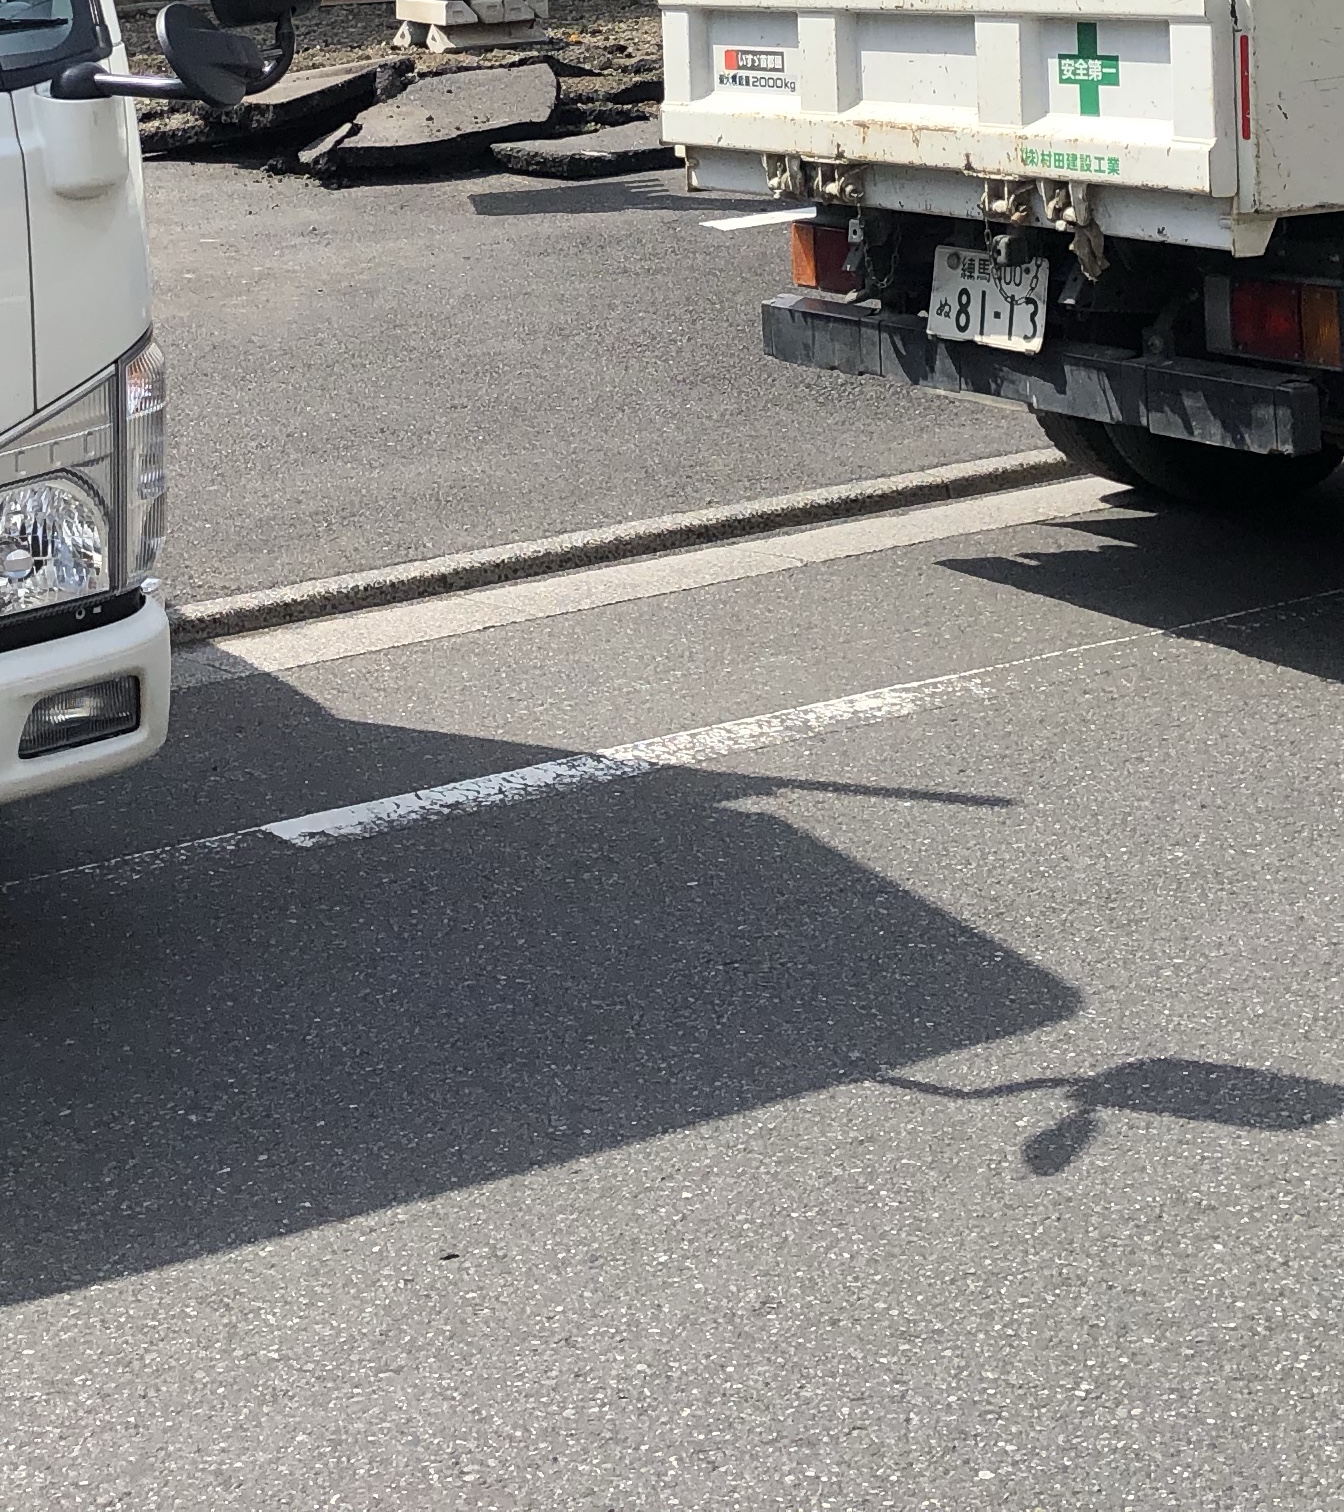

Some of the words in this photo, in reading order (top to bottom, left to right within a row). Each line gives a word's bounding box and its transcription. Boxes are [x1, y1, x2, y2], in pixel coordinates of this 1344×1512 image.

[1060, 58, 1117, 82] 安全第一
[961, 257, 991, 283] 練馬
[935, 296, 952, 319] ぬ
